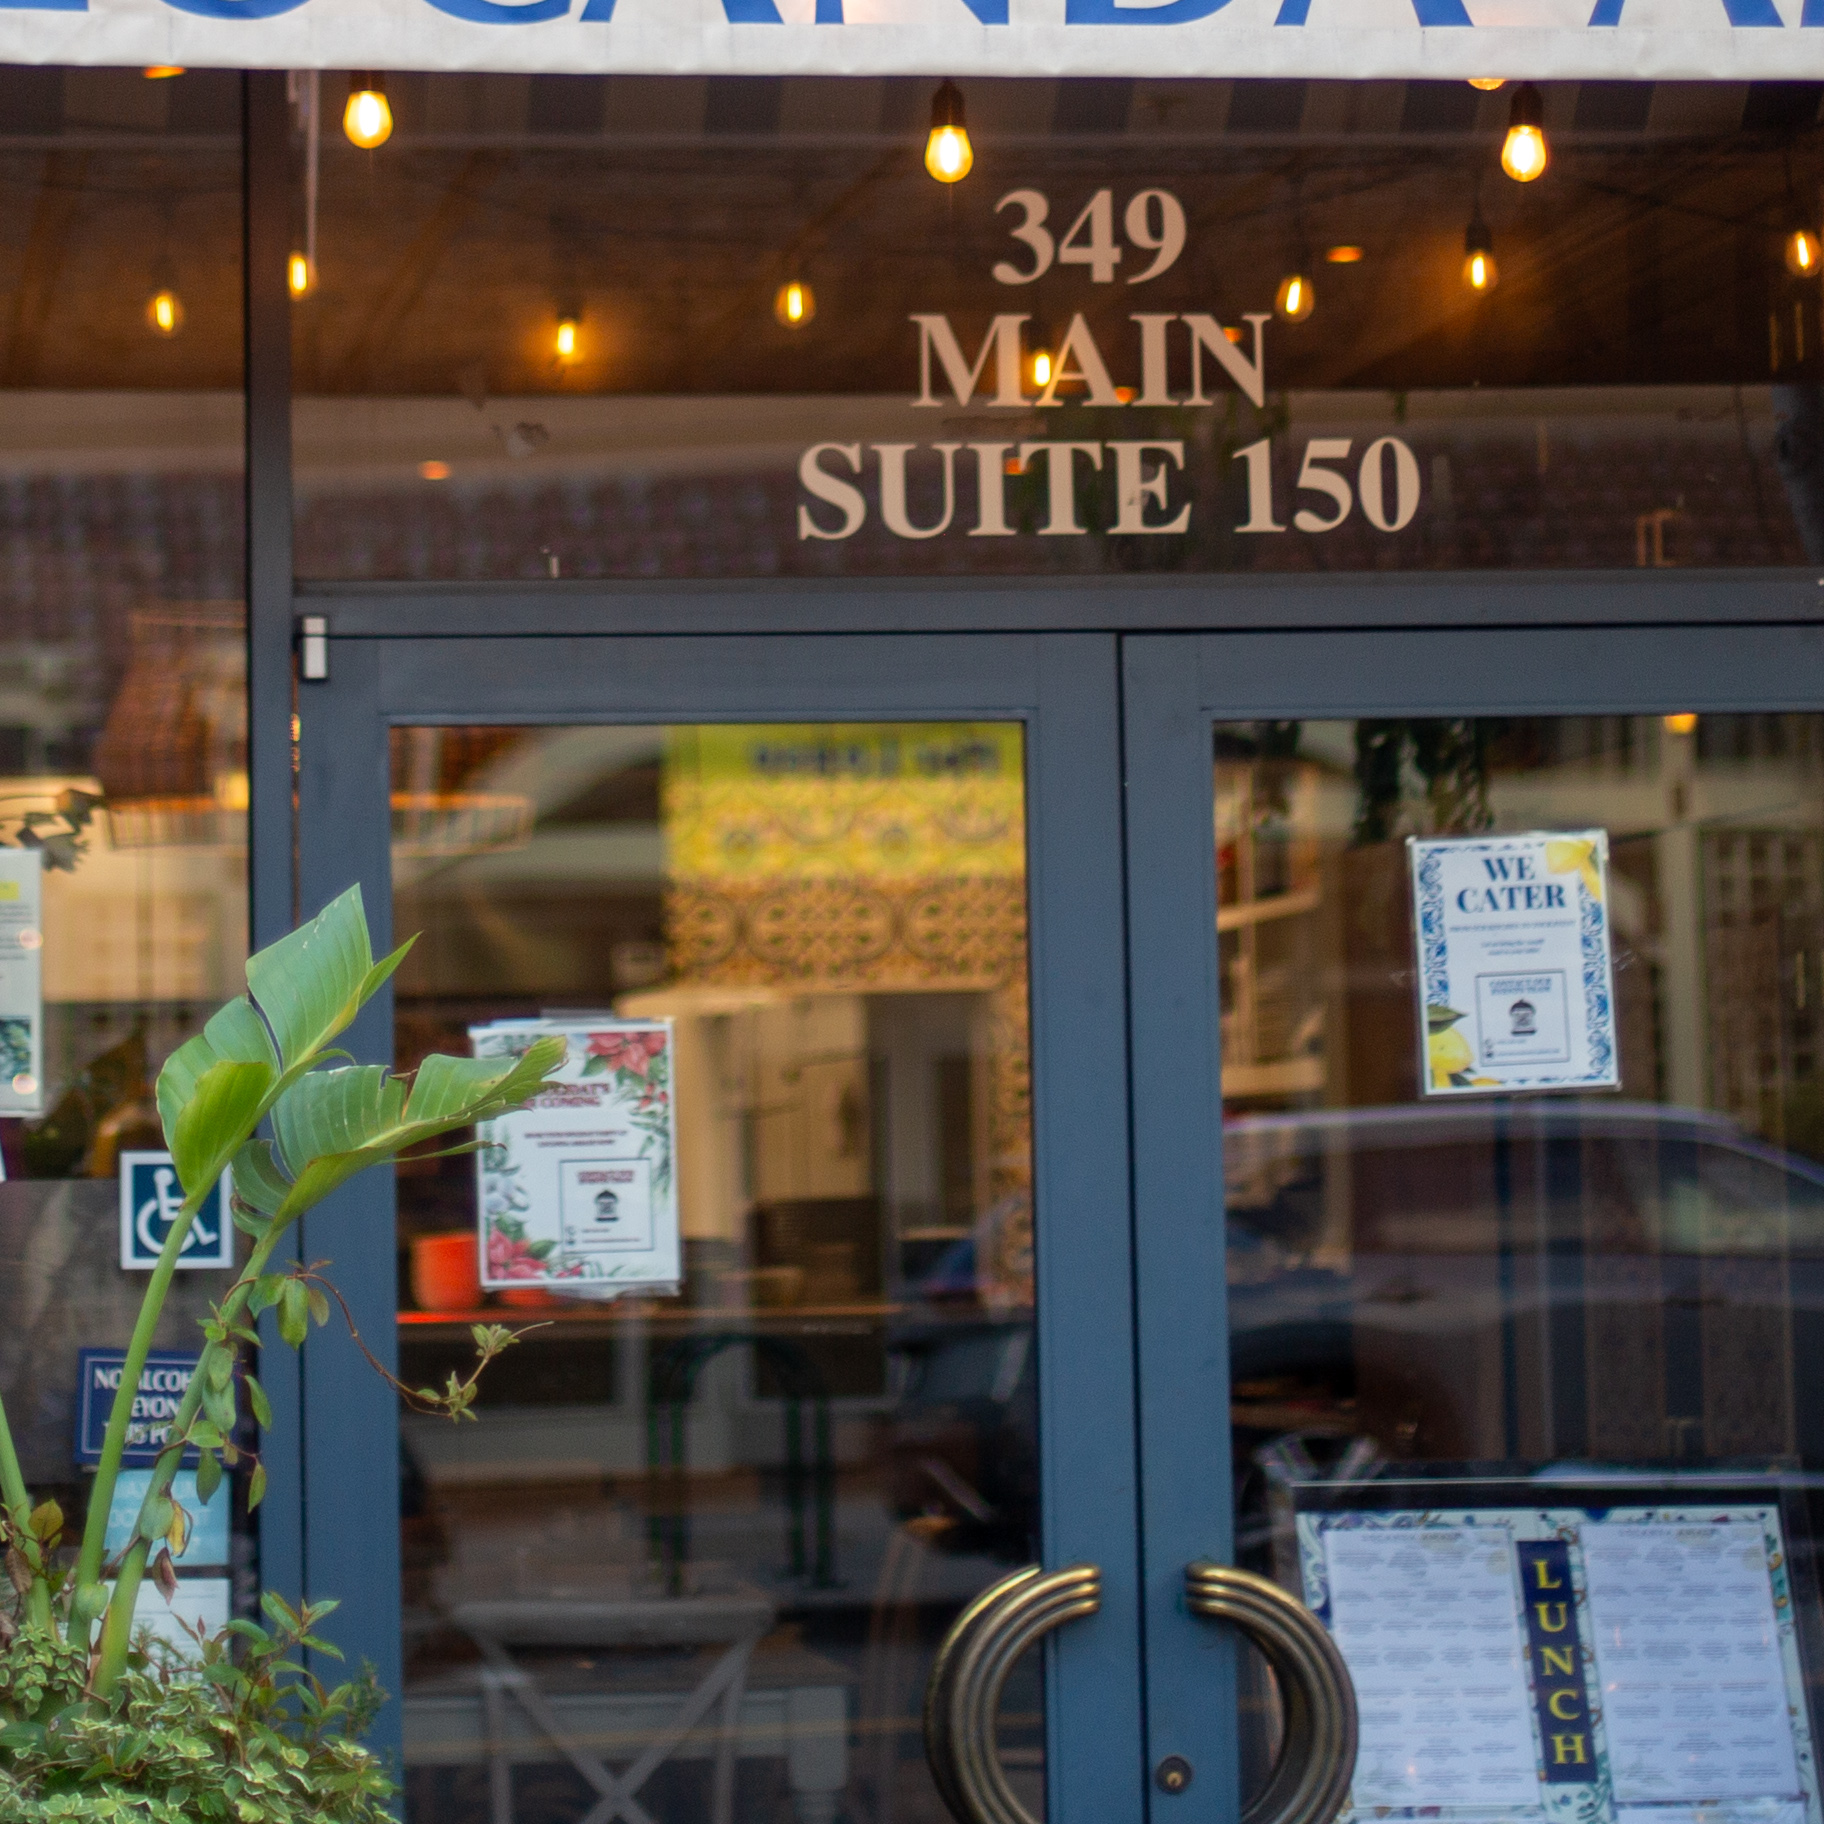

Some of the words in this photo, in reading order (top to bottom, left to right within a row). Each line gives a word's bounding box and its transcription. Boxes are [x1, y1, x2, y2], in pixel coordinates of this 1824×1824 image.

[991, 188, 1187, 285] 349
[909, 311, 1273, 409] MAIN
[797, 440, 1193, 540] SUITE
[1231, 436, 1421, 534] 150
[1456, 884, 1567, 914] CATER
[1483, 856, 1536, 882] WE
[1533, 1558, 1588, 1766] LUNCH
